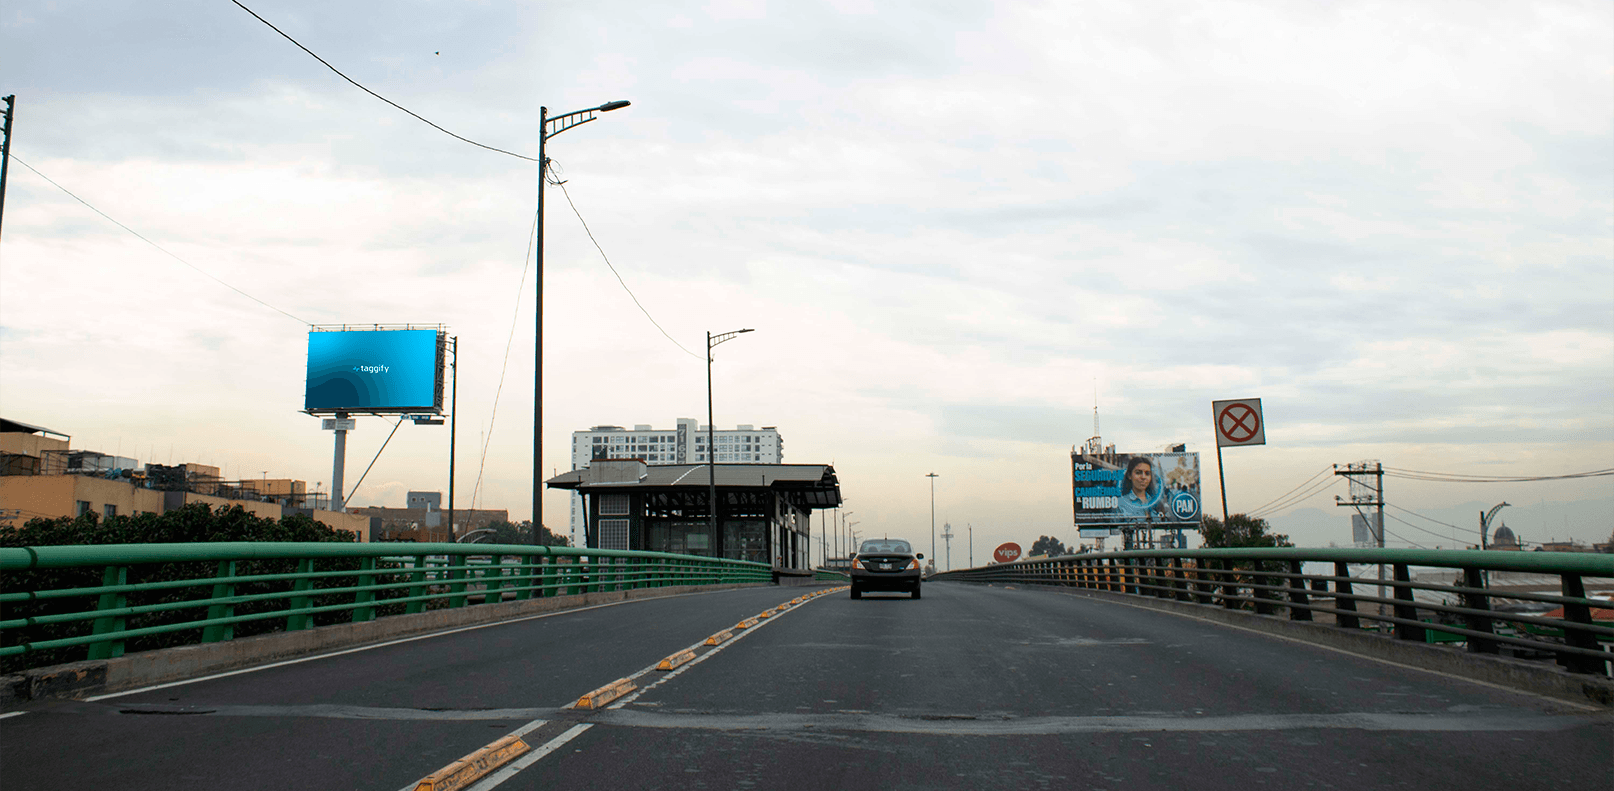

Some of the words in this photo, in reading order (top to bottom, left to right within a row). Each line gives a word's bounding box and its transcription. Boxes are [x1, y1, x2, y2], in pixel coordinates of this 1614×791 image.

[360, 364, 389, 373] taggify
[1074, 462, 1085, 470] Por
[1085, 462, 1093, 470] la
[1074, 487, 1122, 497] CAMBIEMOS
[1082, 496, 1118, 509] RUMBO
[1176, 499, 1194, 513] PAN
[998, 547, 1018, 559] vips
